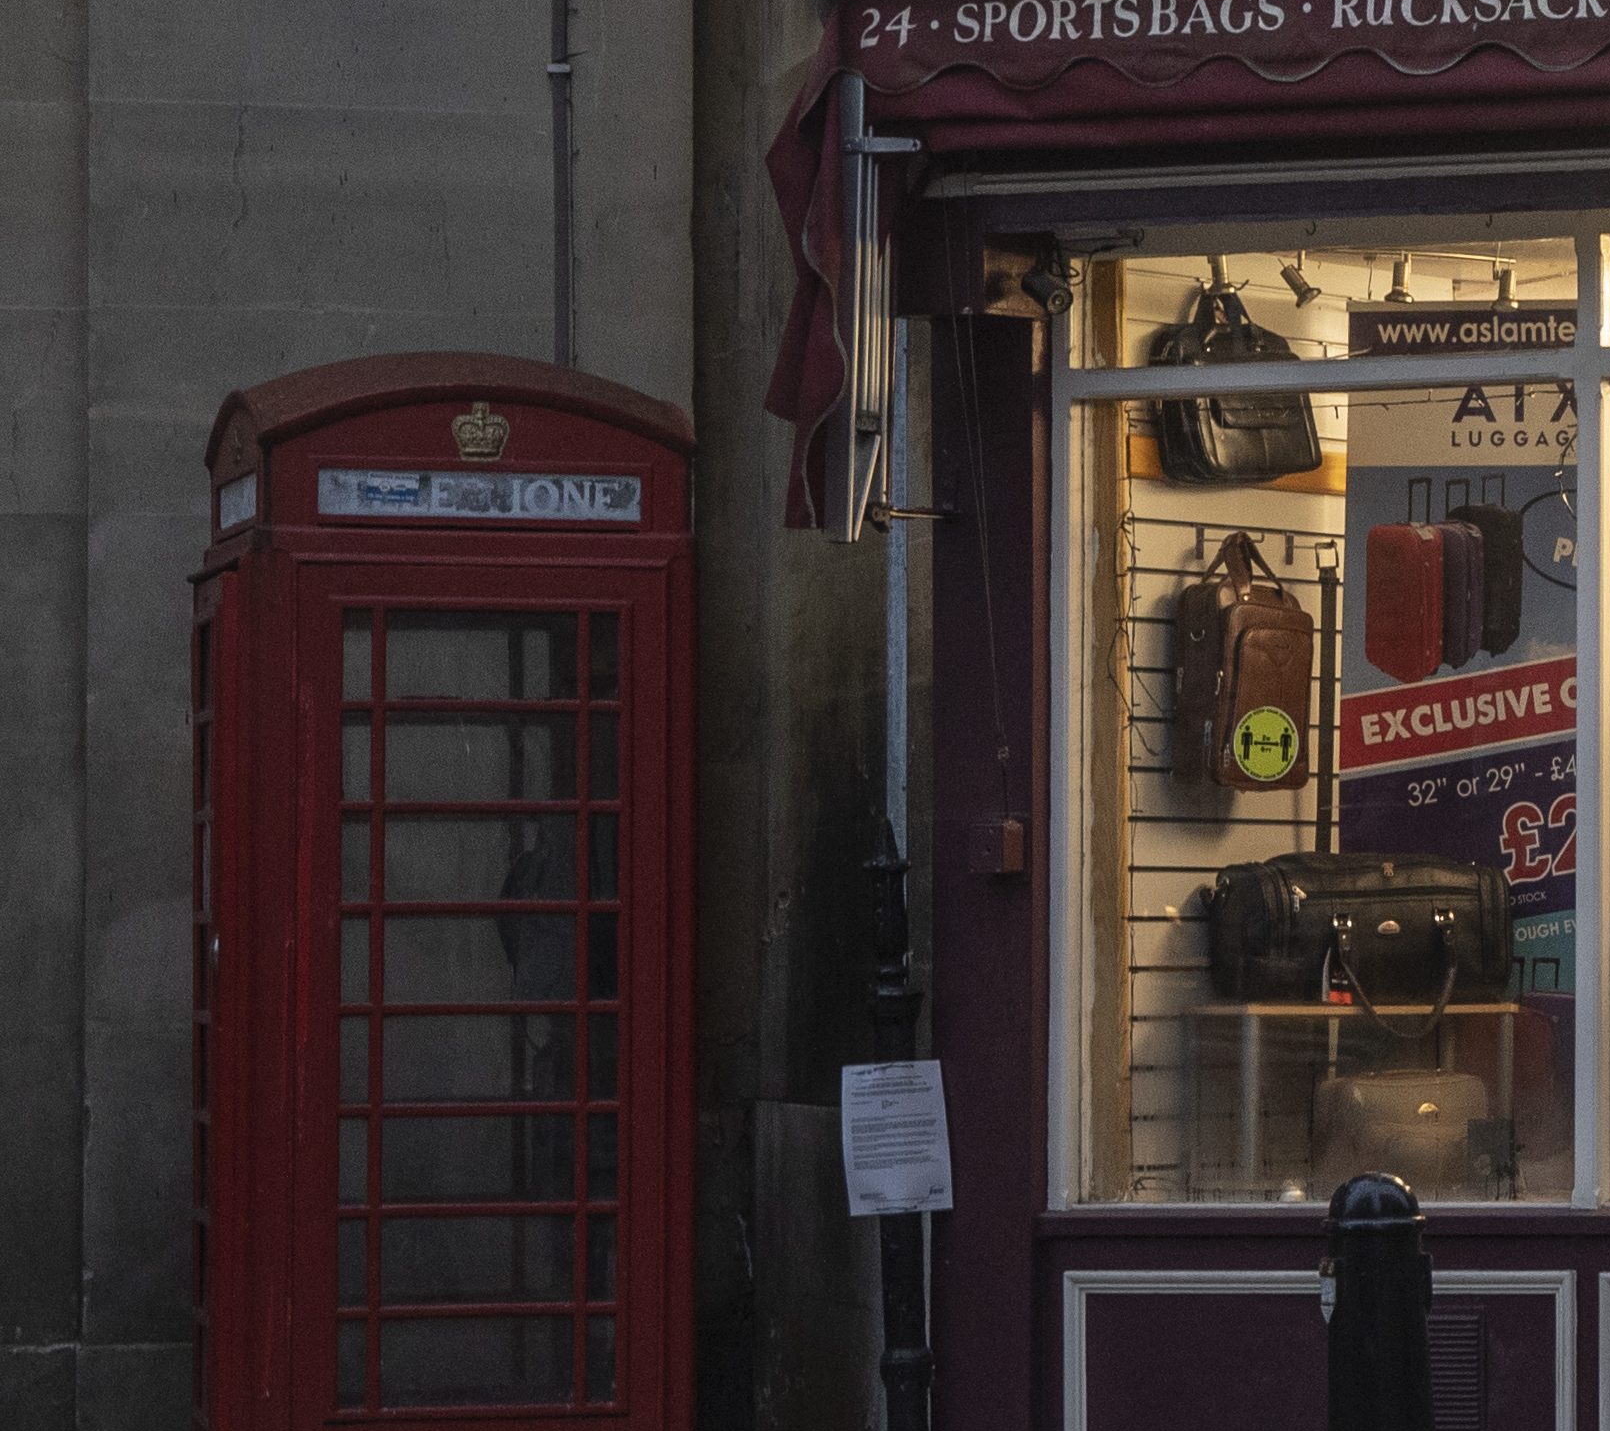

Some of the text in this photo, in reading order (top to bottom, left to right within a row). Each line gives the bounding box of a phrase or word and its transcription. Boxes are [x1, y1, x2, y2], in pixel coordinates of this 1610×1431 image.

[861, 5, 916, 49] 24
[1451, 430, 1572, 447] LUGGAG
[1360, 682, 1553, 746] EXCLUSIVE
[1456, 775, 1481, 798] or
[1517, 890, 1548, 905] STOCK
[1515, 921, 1560, 942] OUGH
